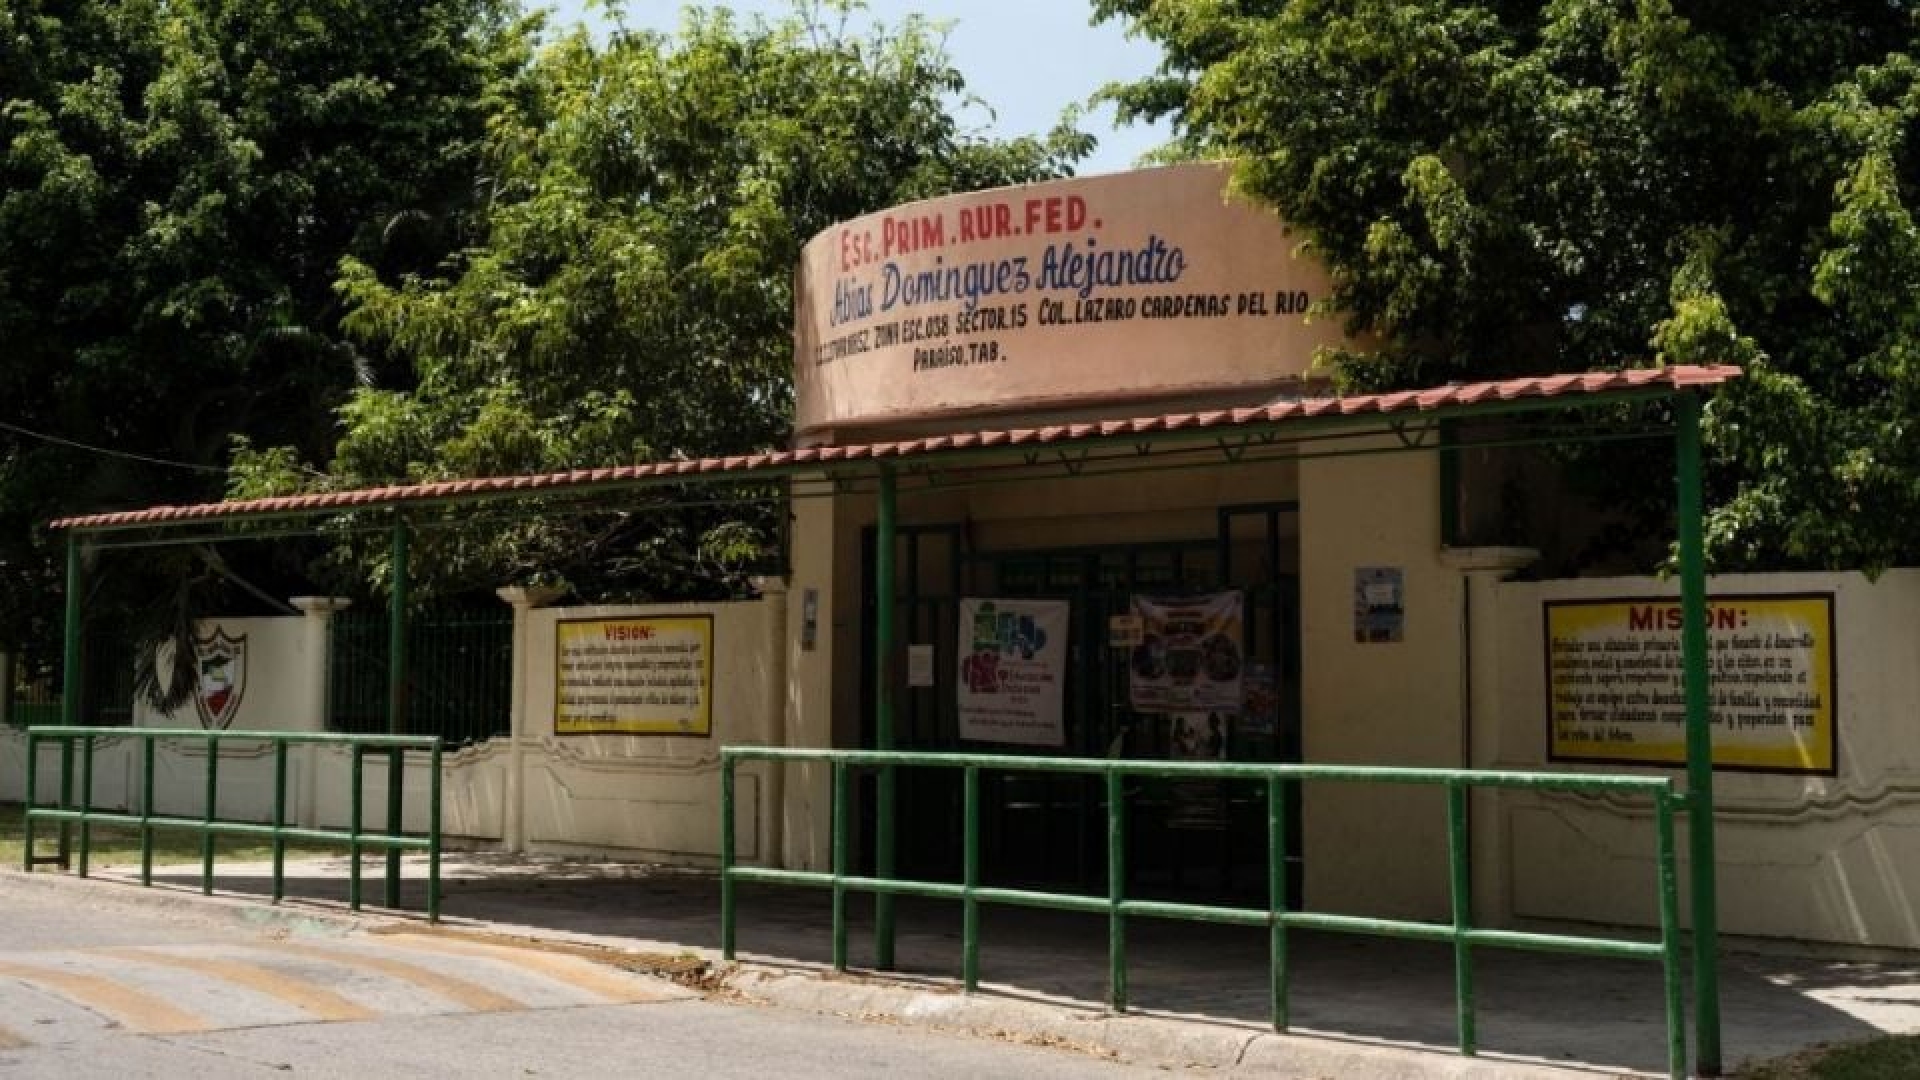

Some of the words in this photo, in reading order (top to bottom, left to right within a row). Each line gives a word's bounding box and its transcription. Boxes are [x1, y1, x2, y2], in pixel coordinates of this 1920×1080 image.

[1035, 234, 1188, 299] Alejandro
[1141, 293, 1232, 319] CARDENAS
[1238, 291, 1267, 316] DEL
[1275, 290, 1310, 314] RIO
